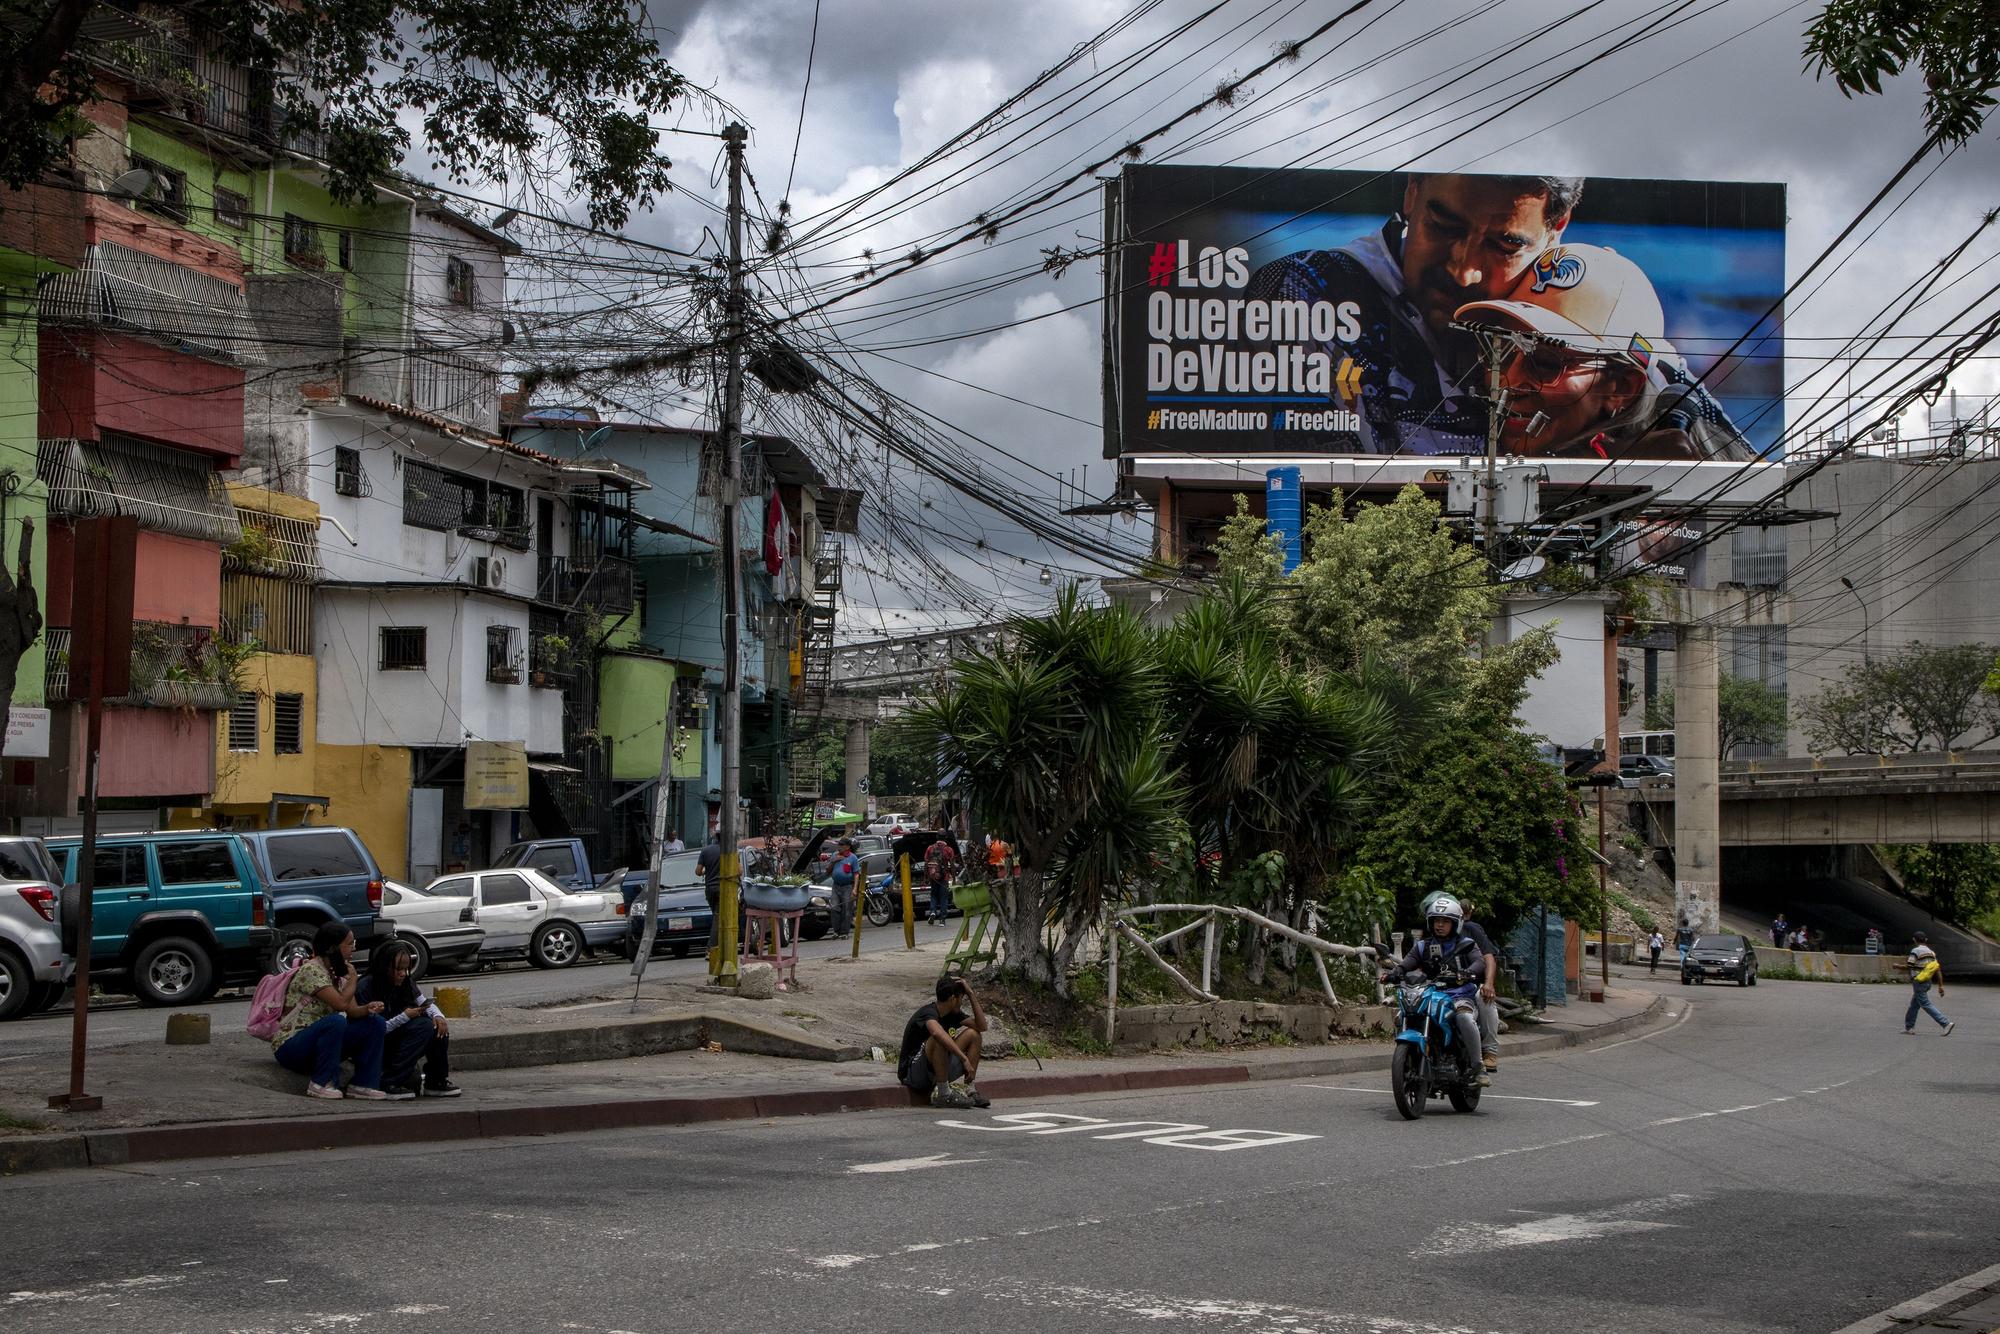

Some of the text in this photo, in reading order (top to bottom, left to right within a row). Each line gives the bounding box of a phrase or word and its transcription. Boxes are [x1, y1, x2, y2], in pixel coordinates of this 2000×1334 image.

[1148, 239, 1249, 288] #Los
[1148, 291, 1361, 343] Queremos
[1148, 343, 1331, 393] DeVuelta
[1147, 408, 1360, 431] #FreeMaduro #FreeCilia
[1682, 523, 1702, 540] Óscar
[1669, 564, 1685, 575] estar
[936, 1112, 1324, 1151] BUS
